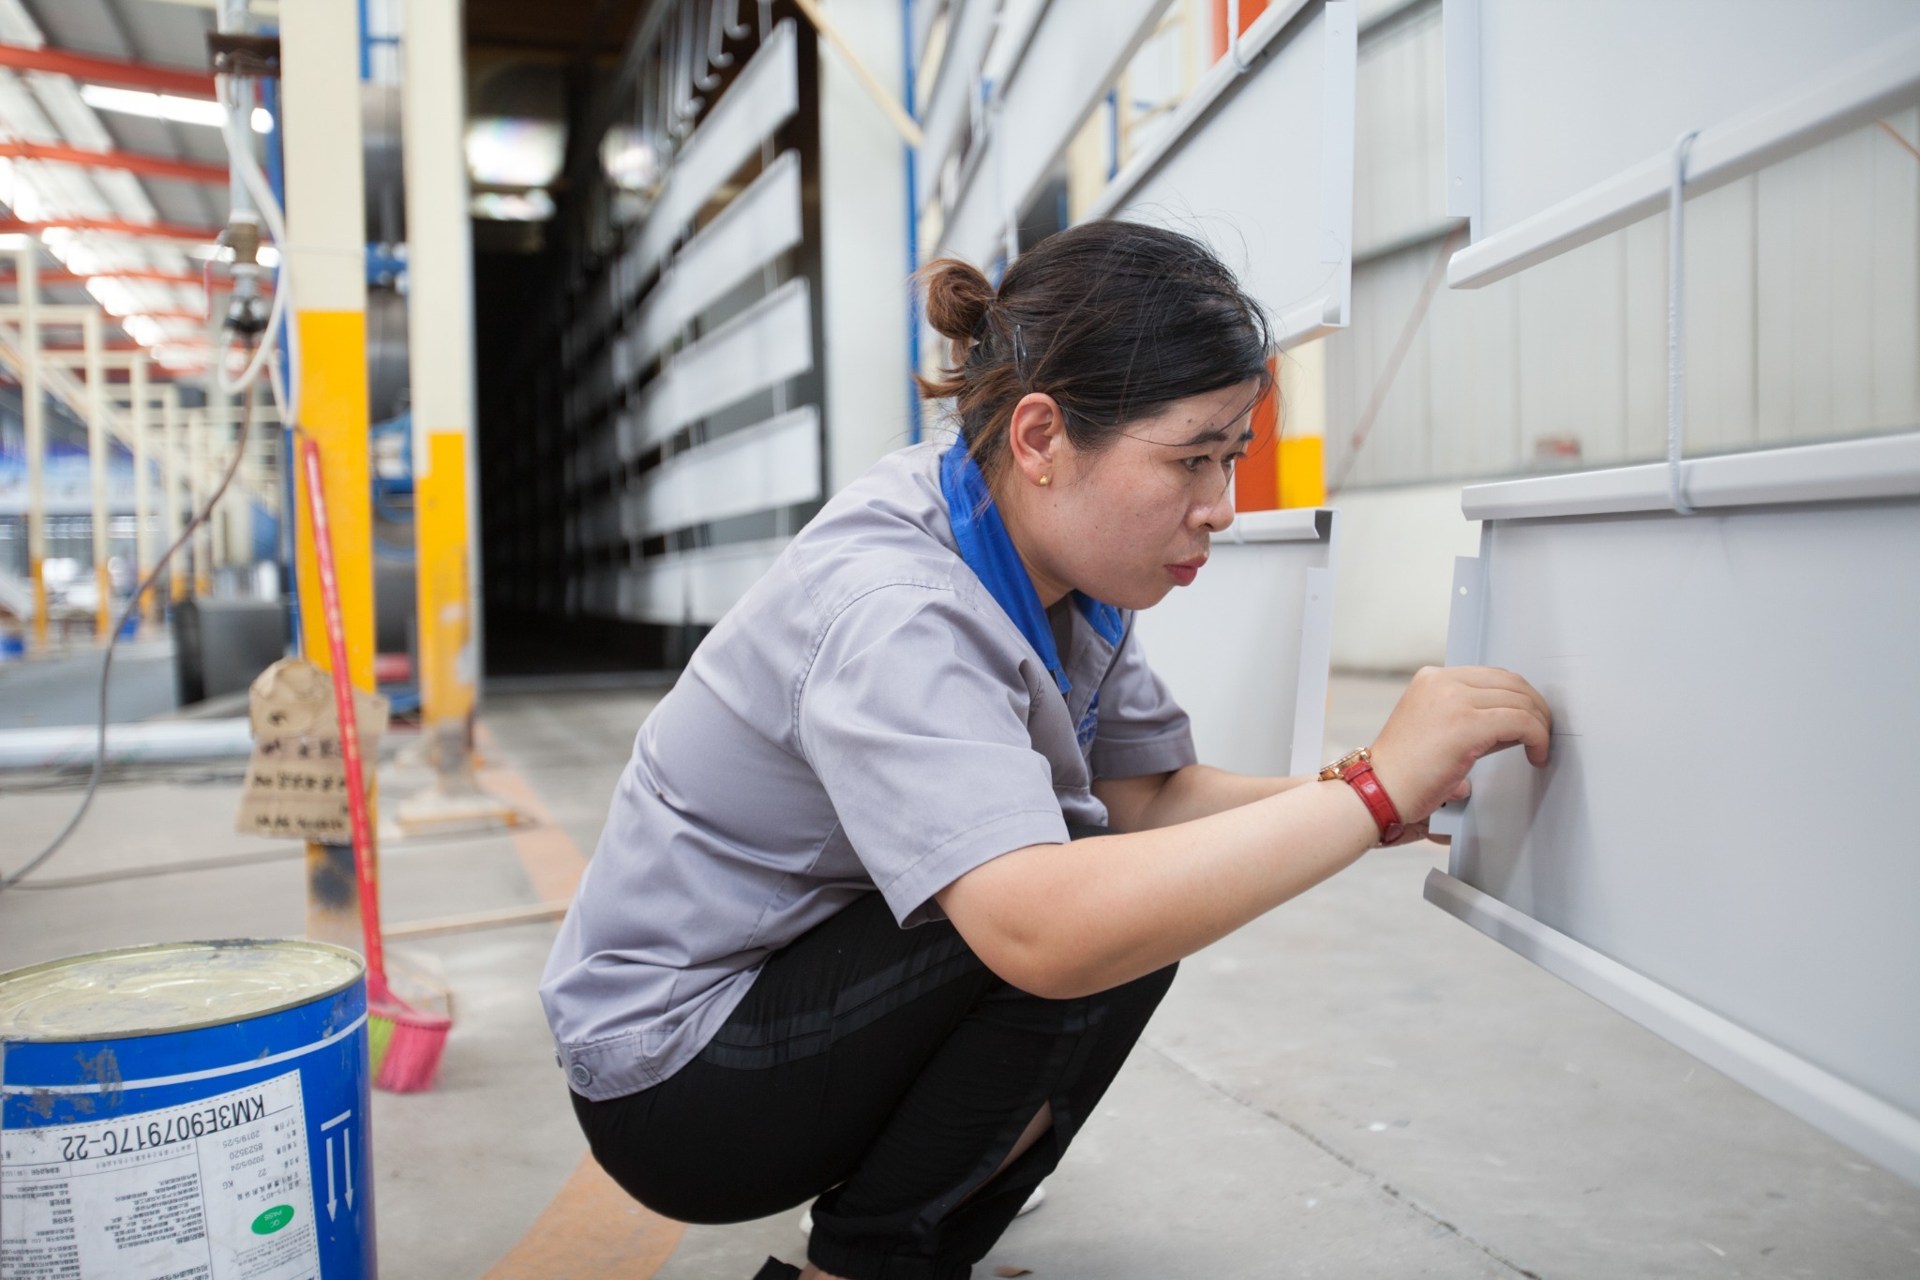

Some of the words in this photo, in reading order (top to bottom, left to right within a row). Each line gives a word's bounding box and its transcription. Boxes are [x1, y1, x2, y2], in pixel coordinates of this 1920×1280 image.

[61, 1095, 265, 1162] KM3E907917C-22
[222, 1130, 260, 1148] 2019/5/25
[229, 1142, 263, 1160] 8523520
[257, 1168, 267, 1178] 22
[222, 1180, 234, 1190] KG
[263, 1209, 283, 1221] PASS
[270, 1219, 280, 1229] QC
